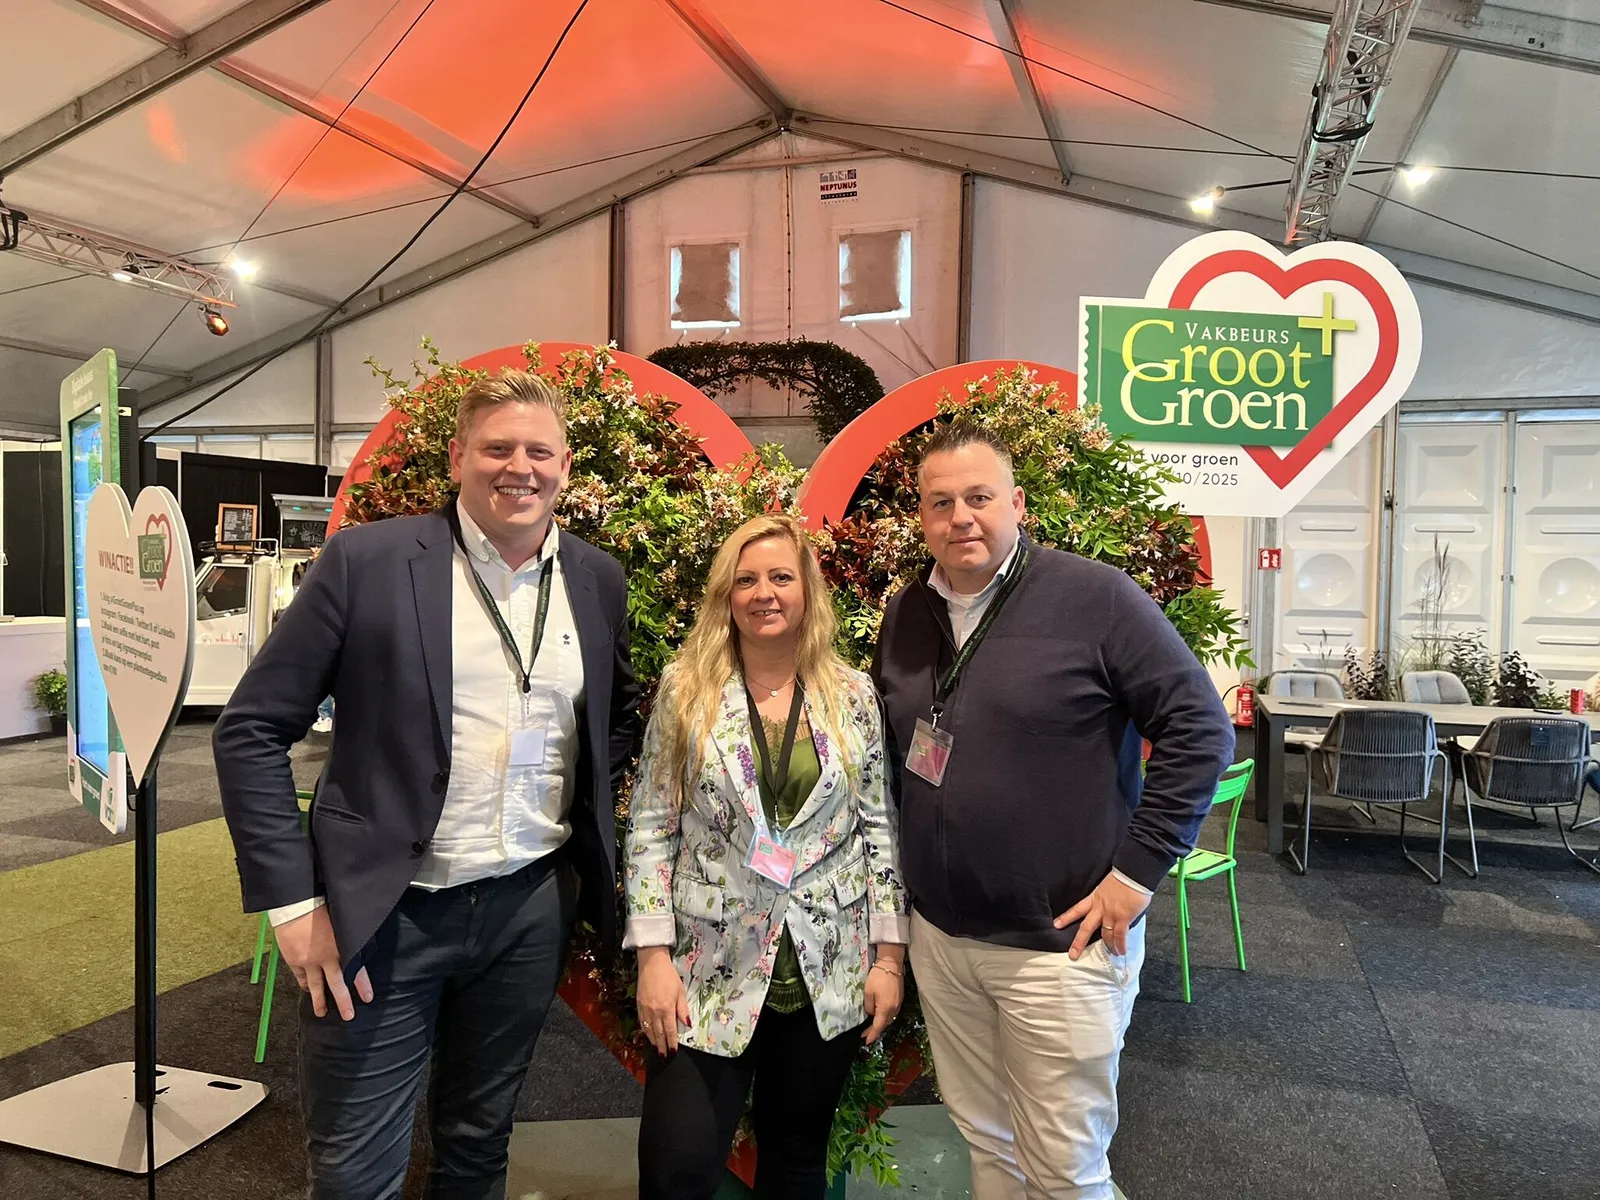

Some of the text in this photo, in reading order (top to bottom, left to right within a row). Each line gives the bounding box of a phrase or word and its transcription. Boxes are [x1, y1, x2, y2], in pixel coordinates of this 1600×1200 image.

[820, 181, 857, 192] NEPTUNUS
[1184, 322, 1290, 344] VAKBEURS
[1121, 319, 1312, 389] Groot
[1119, 362, 1309, 431] Groen
[1151, 453, 1187, 464] voor
[1192, 454, 1239, 468] groen
[98, 550, 135, 575] WINACTIE!!
[142, 552, 164, 573] Groen
